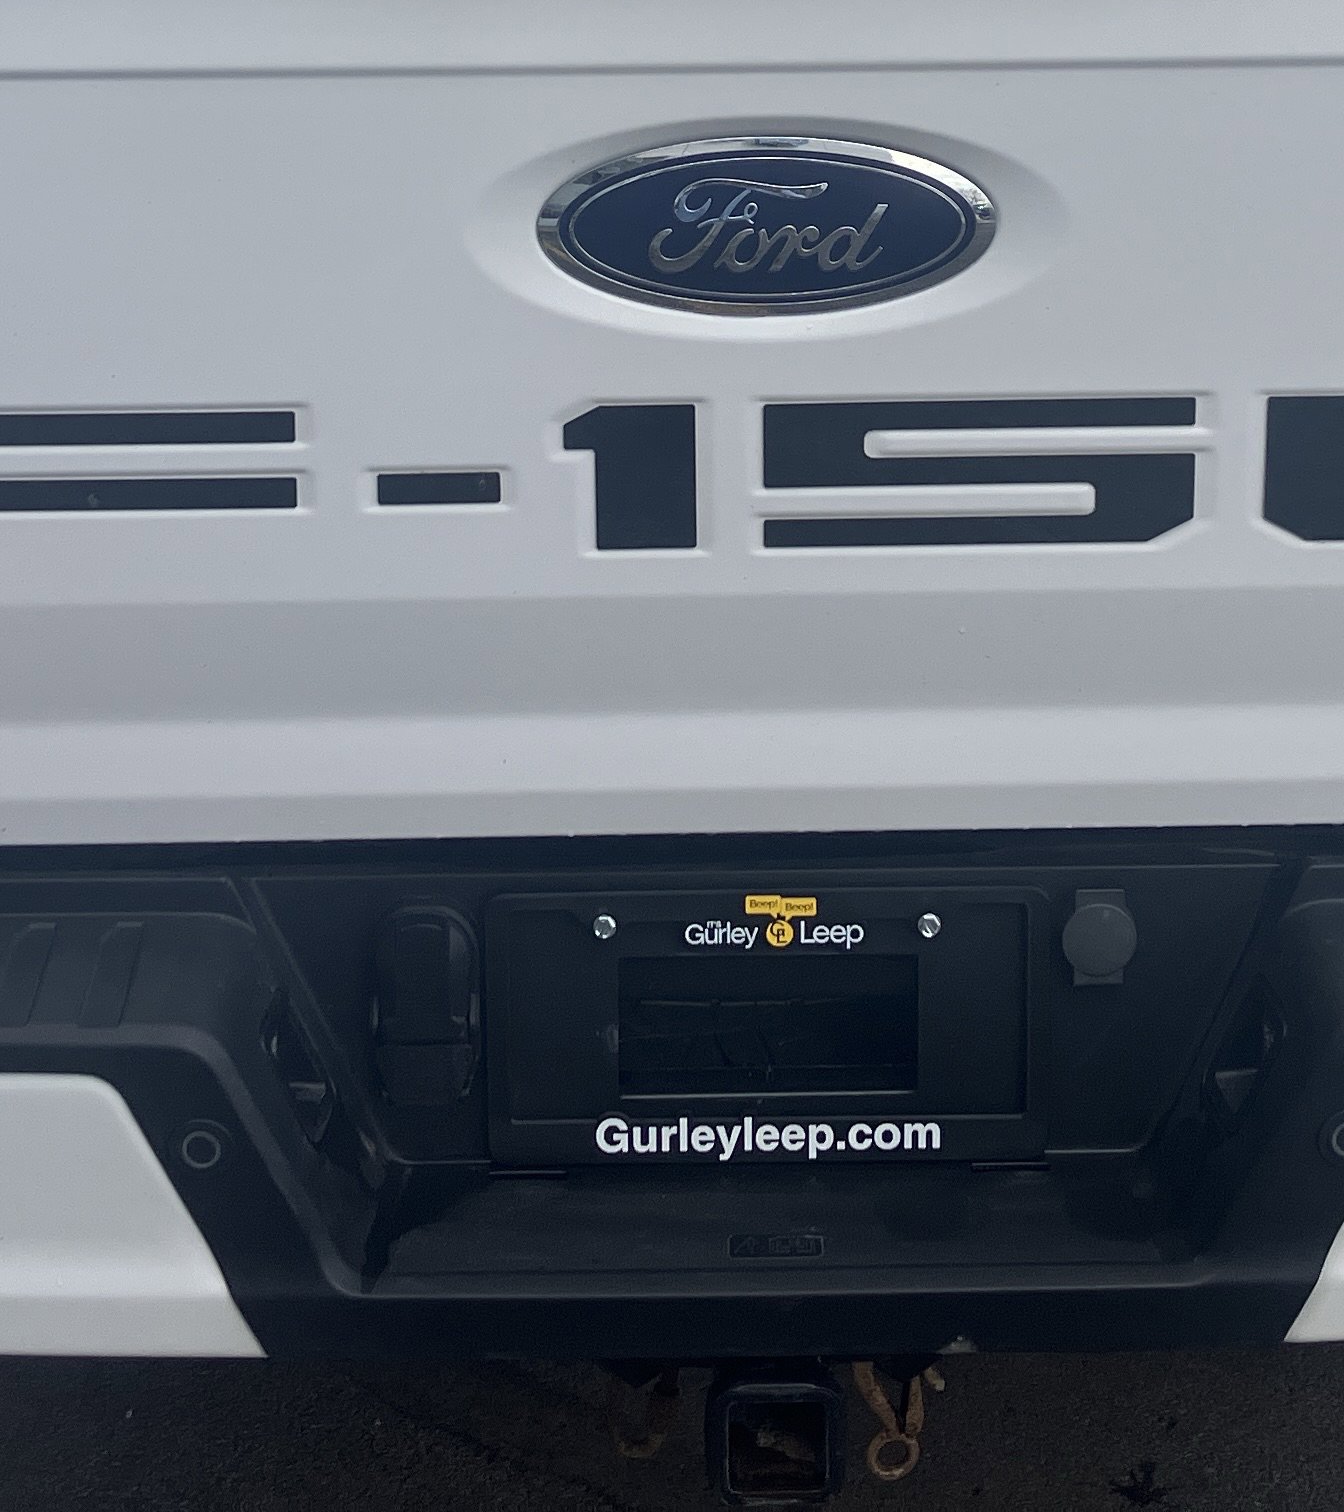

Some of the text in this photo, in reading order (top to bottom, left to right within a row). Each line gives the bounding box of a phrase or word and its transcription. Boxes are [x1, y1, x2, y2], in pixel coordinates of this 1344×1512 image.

[648, 178, 889, 274] Ford
[750, 899, 814, 913] Beep! Beep!
[684, 921, 759, 949] Gurley
[800, 920, 864, 950] Leep
[596, 1116, 941, 1161] Gurleyleep.com
